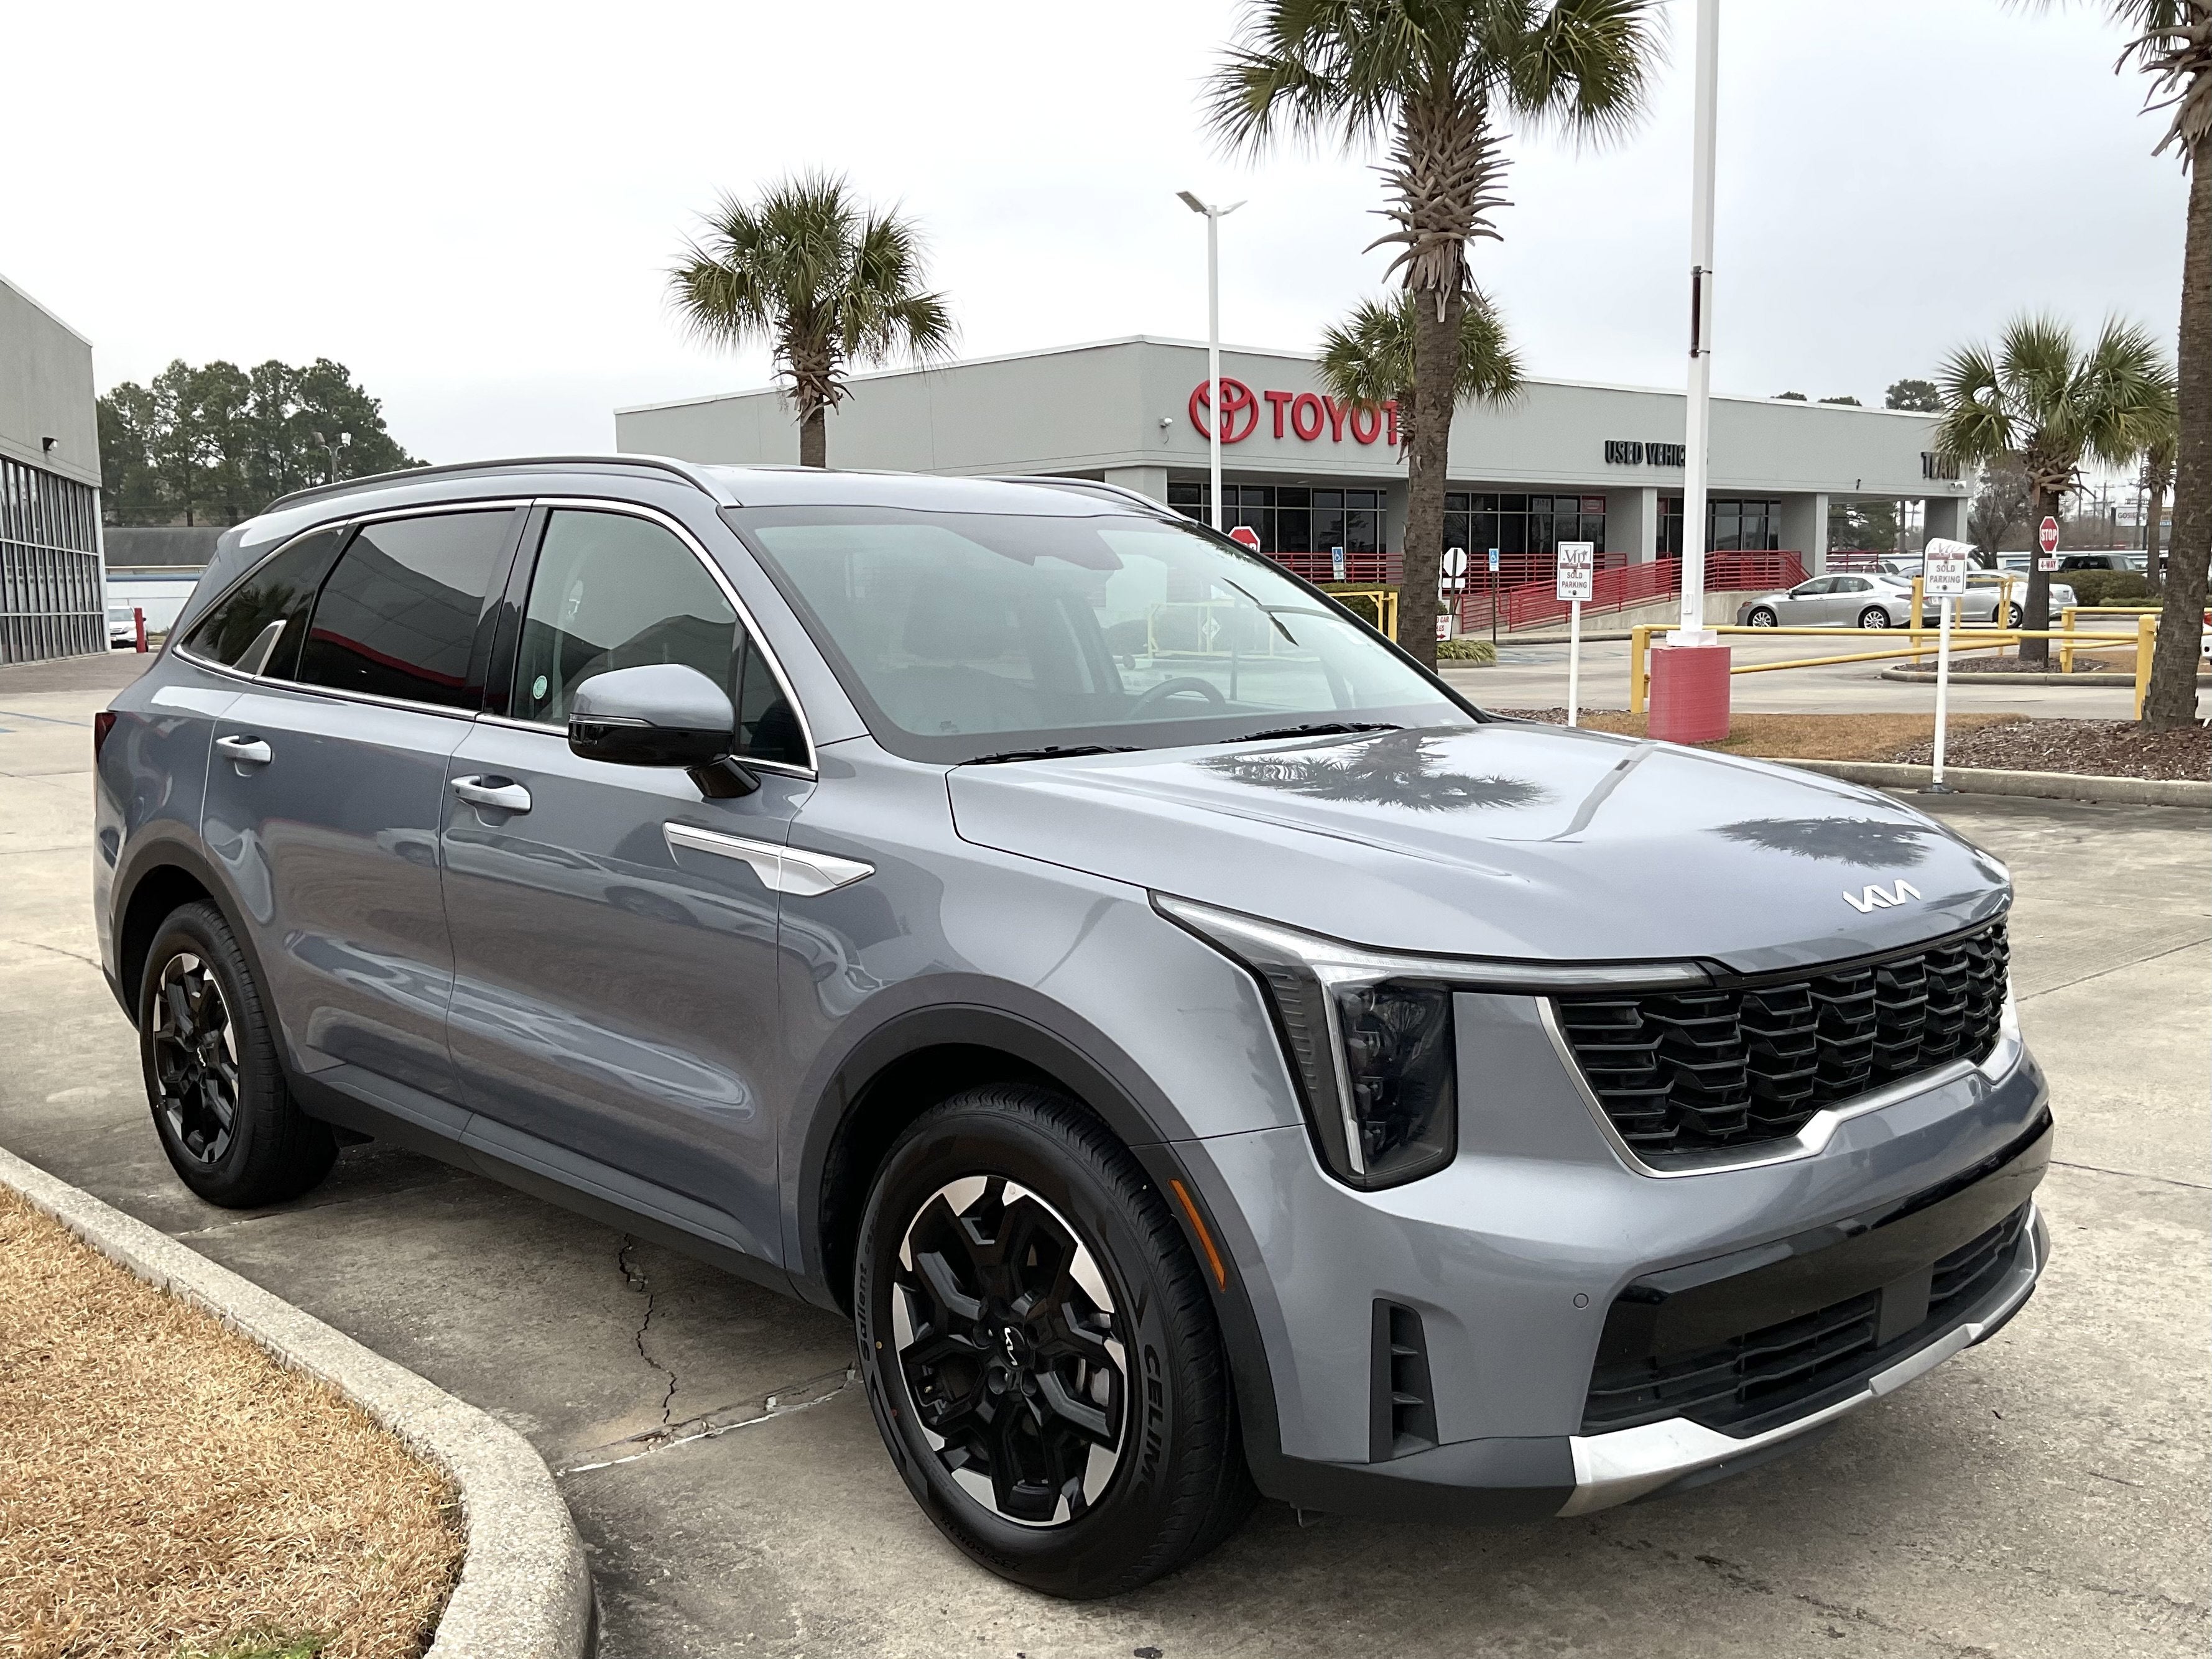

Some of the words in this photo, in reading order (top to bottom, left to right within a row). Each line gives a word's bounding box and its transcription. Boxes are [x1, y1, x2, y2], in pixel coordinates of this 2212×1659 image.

[1264, 390, 1398, 445] TOYOT
[1604, 440, 1644, 464] USED
[1645, 442, 1708, 466] VEHIC
[2041, 529, 2057, 542] STOP
[1936, 565, 1955, 573] SOLD
[2040, 560, 2057, 568] 4-WAY
[1929, 575, 1961, 583] PARKING
[1138, 1343, 1164, 1490] CELIM
